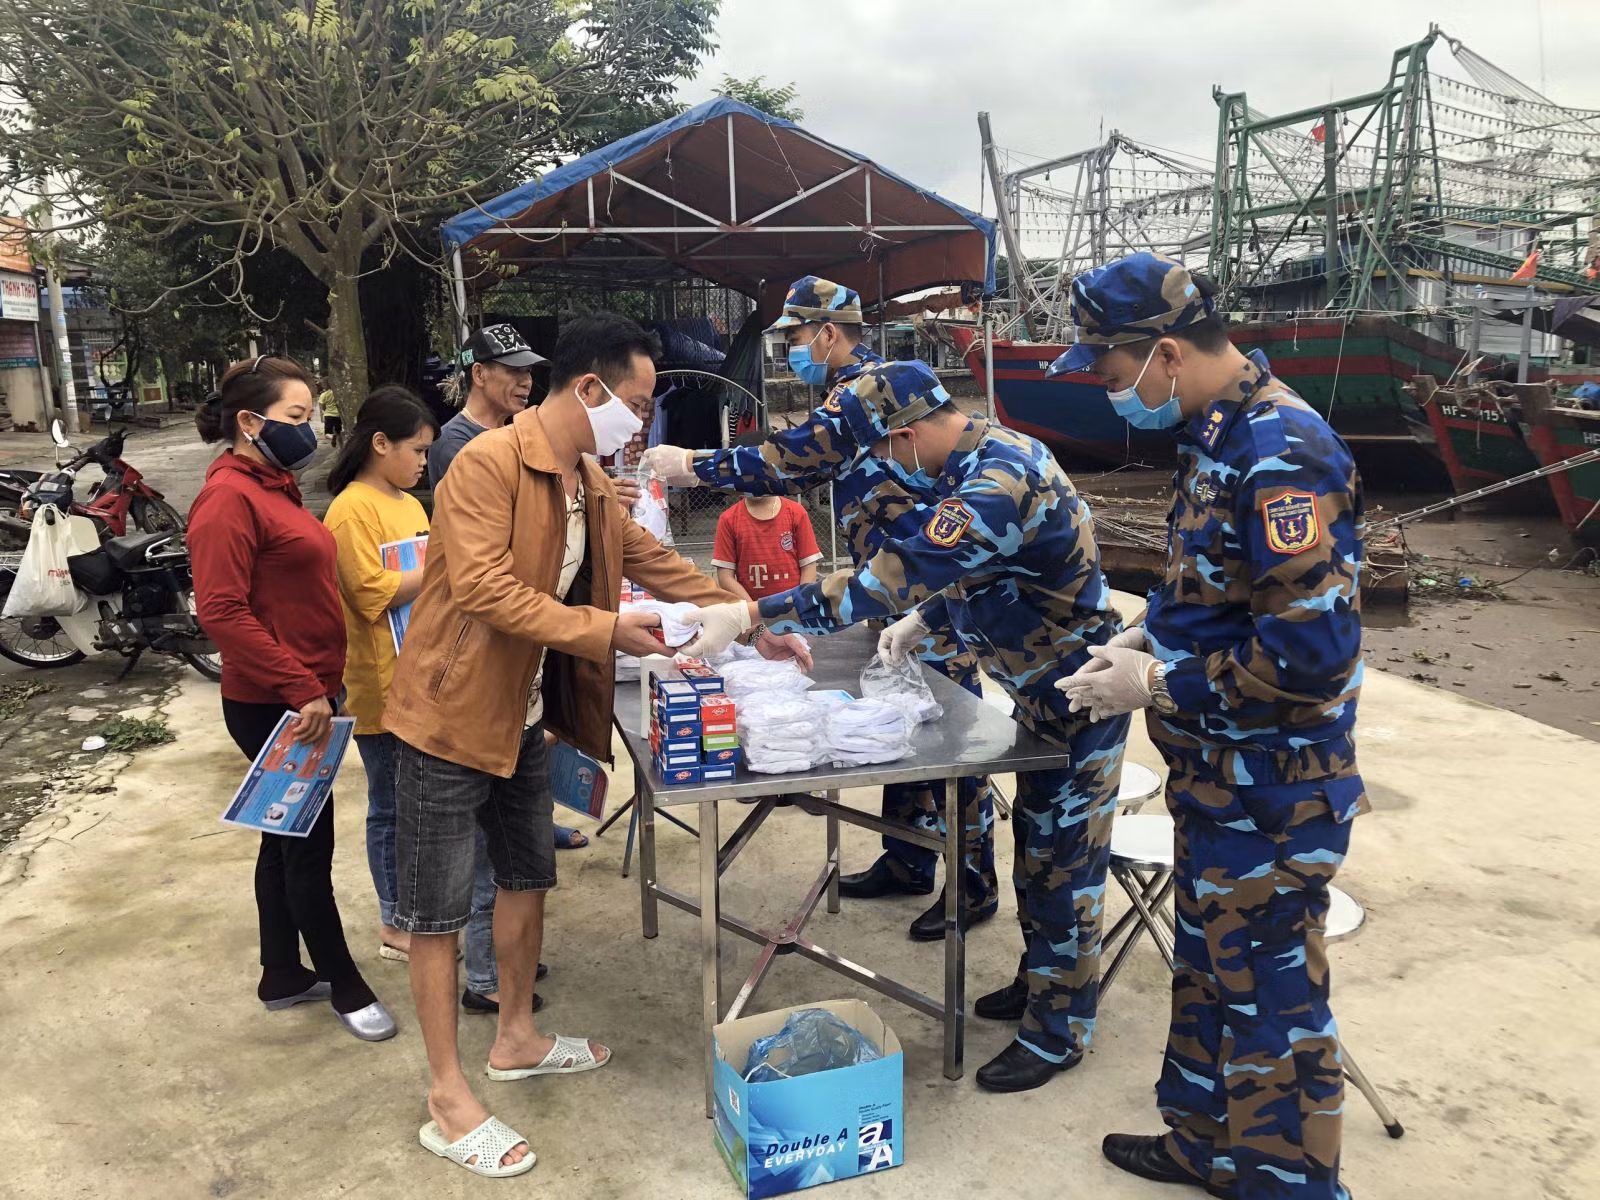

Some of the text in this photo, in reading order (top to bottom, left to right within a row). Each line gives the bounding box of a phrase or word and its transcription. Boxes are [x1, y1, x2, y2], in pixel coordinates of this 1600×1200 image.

[764, 1141, 847, 1169] EVERYDAY
[766, 1127, 848, 1157] Double A
